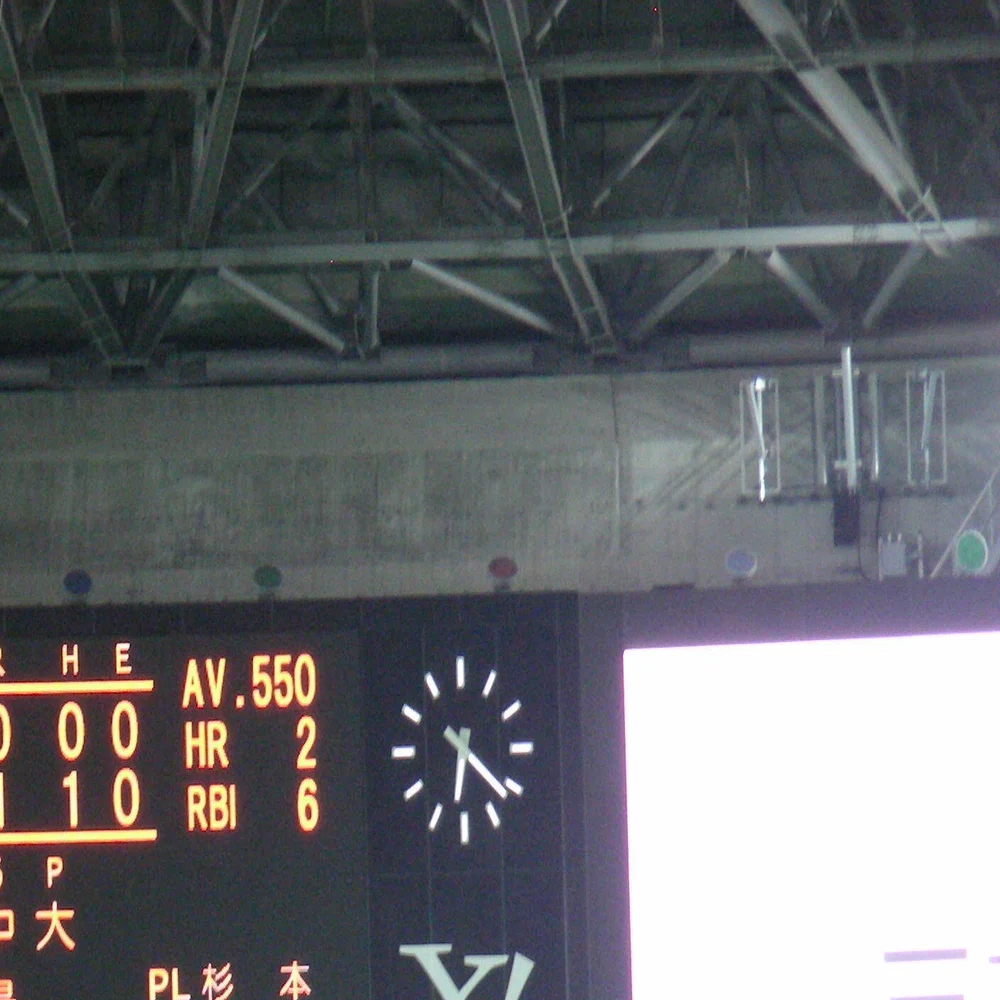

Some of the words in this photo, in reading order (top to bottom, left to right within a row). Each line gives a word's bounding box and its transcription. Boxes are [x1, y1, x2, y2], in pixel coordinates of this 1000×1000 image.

[62, 644, 78, 675] H
[116, 643, 132, 675] E
[182, 658, 226, 709] AV
[236, 653, 316, 709] .550
[58, 701, 85, 760] 0
[110, 700, 139, 760] 0
[184, 720, 229, 768] HR
[296, 715, 317, 769] 2
[63, 770, 78, 828] 1
[113, 767, 141, 827] 0
[187, 784, 236, 832] RBI
[297, 777, 319, 832] 6
[47, 856, 63, 888] P
